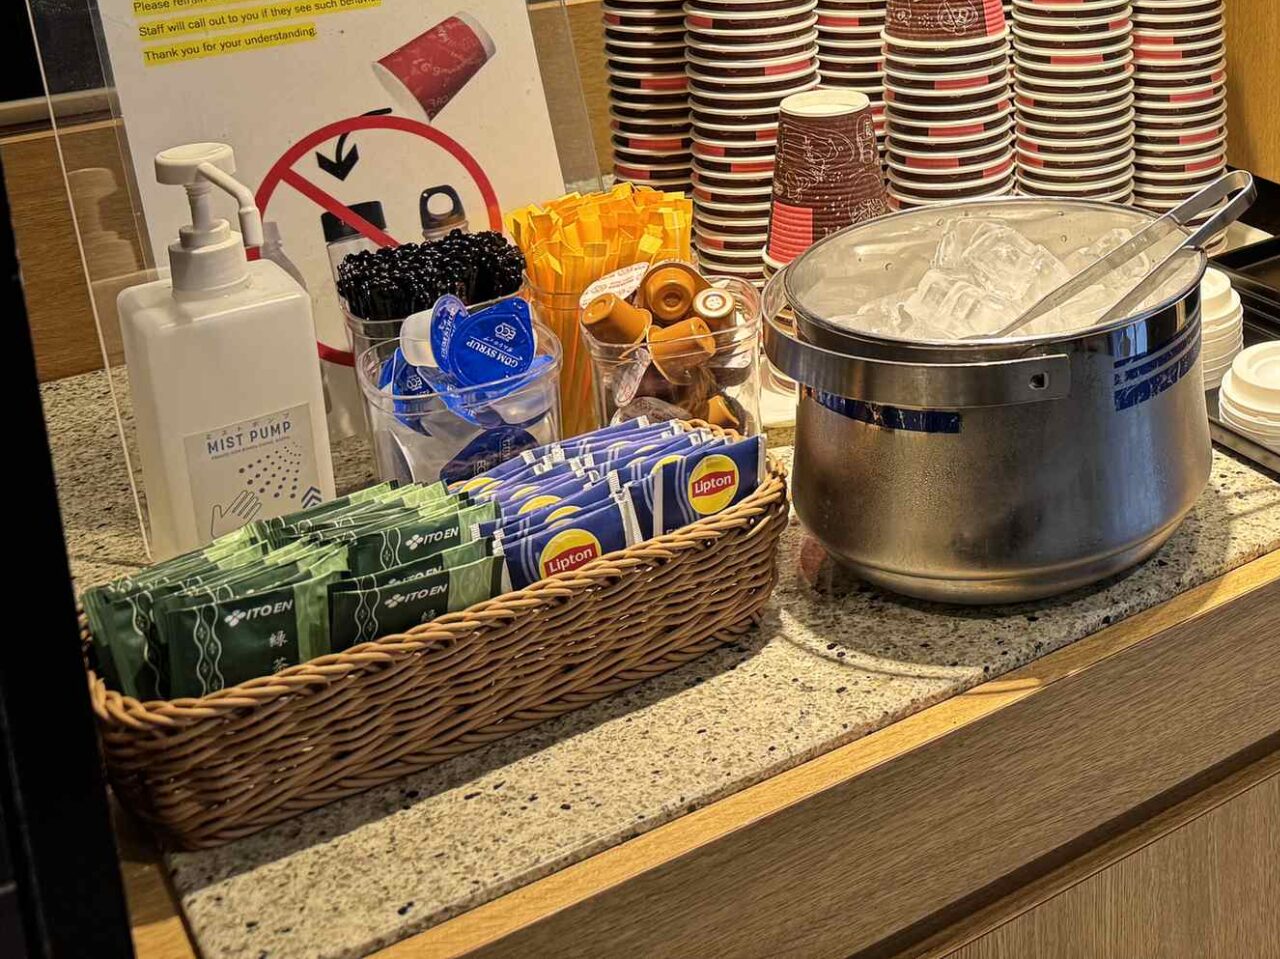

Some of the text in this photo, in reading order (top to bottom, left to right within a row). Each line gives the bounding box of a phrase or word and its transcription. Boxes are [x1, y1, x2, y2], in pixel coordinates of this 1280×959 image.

[133, 0, 170, 13] Please
[139, 22, 165, 37] Staff
[167, 20, 185, 32] will
[188, 17, 207, 29] call
[208, 15, 226, 27] out
[228, 13, 239, 24] to
[241, 12, 259, 25] you
[261, 8, 269, 19] if
[270, 6, 292, 20] they
[295, 5, 312, 14] see
[144, 26, 317, 62] Thank you for your understanding.
[466, 340, 498, 358] SYRUP
[207, 433, 243, 454] MIST
[250, 421, 291, 442] PUMP
[694, 474, 732, 495] Lipton
[422, 526, 459, 545] ITO EN
[549, 548, 593, 573] Lipton
[404, 583, 448, 604] ITO EN
[245, 599, 294, 622] ITO EN
